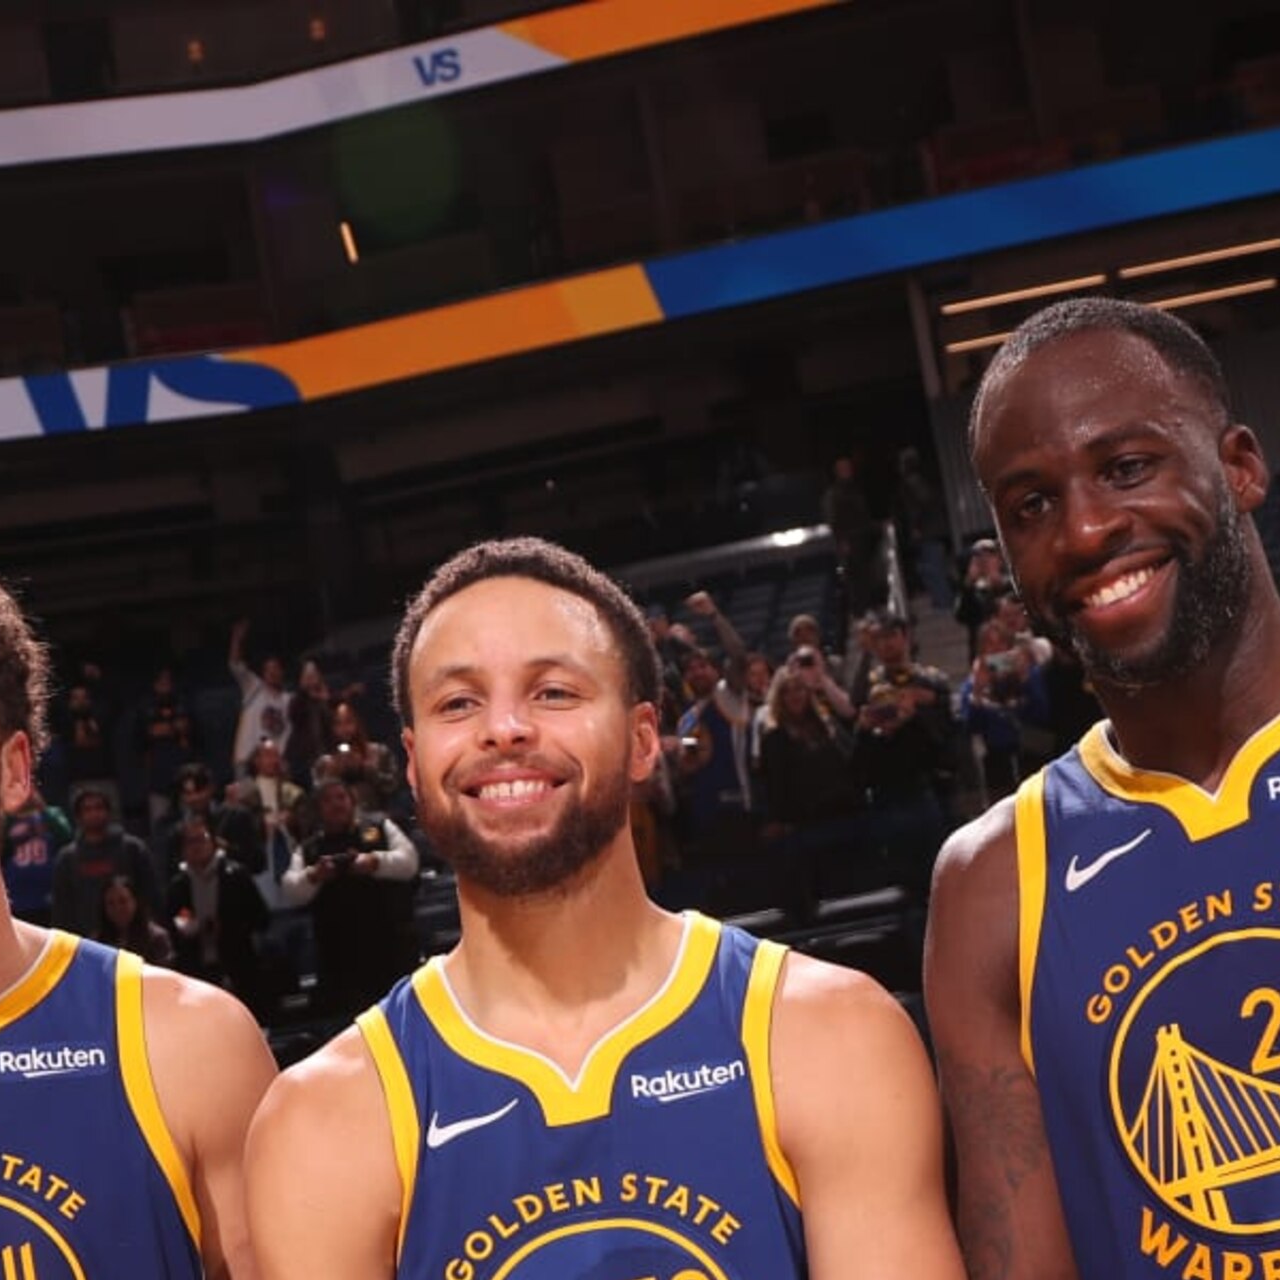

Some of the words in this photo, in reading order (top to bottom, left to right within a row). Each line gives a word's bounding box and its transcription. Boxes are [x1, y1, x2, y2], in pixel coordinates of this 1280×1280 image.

[412, 47, 462, 86] VS
[1086, 888, 1234, 1025] GOLDEN
[0, 1046, 106, 1079] Rakuten
[631, 1059, 745, 1102] Rakuten
[620, 1173, 743, 1247] STATE
